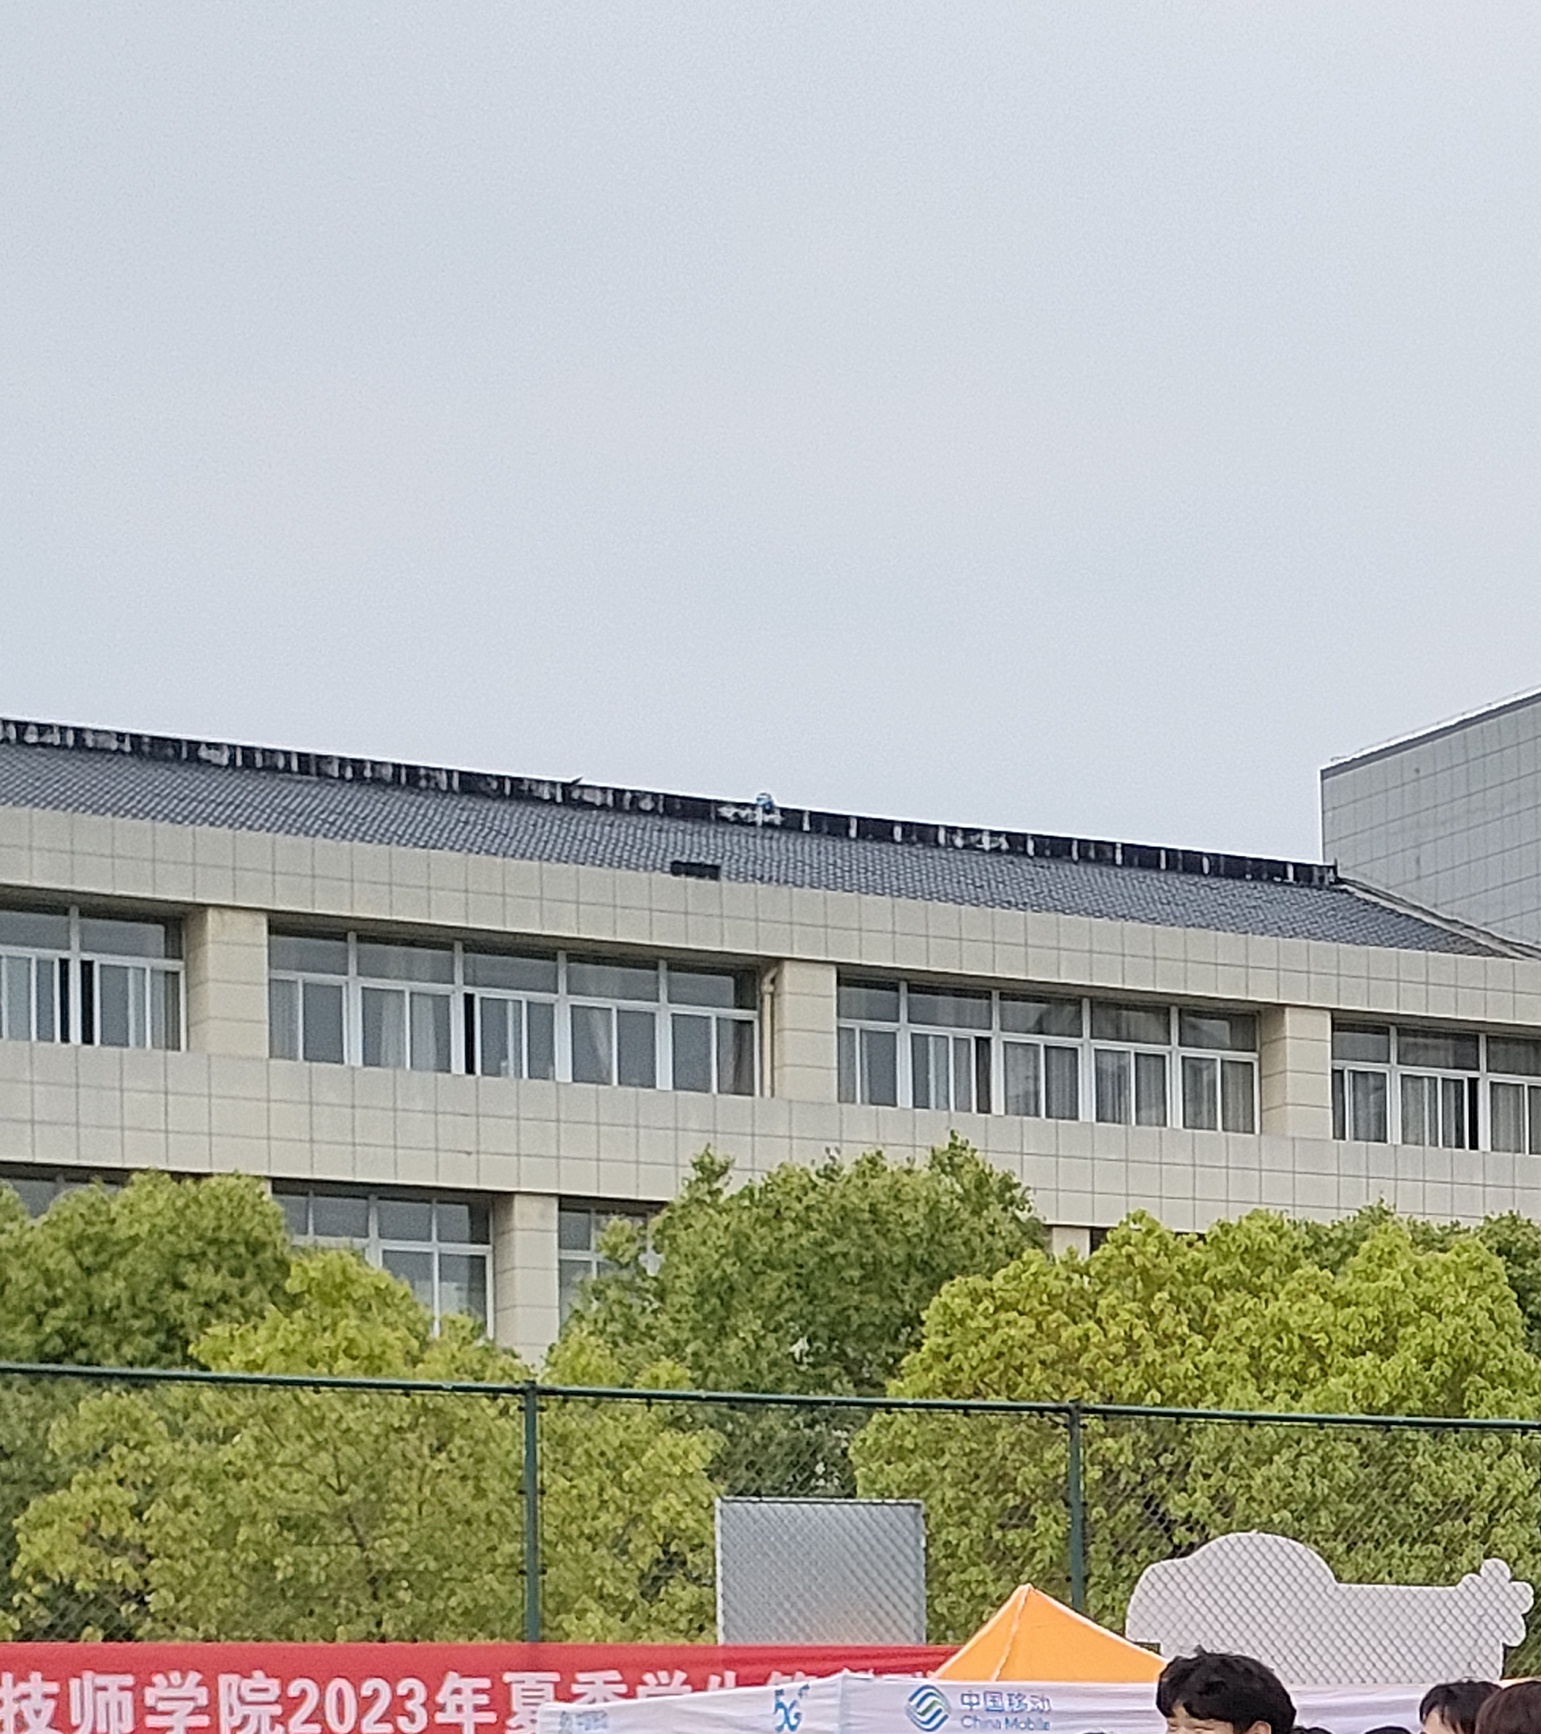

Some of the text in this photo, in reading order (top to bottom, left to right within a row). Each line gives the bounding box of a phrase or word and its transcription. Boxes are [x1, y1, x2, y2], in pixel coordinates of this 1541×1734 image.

[961, 1690, 1053, 1713] 中国移动
[961, 1715, 1051, 1731] China Mobile
